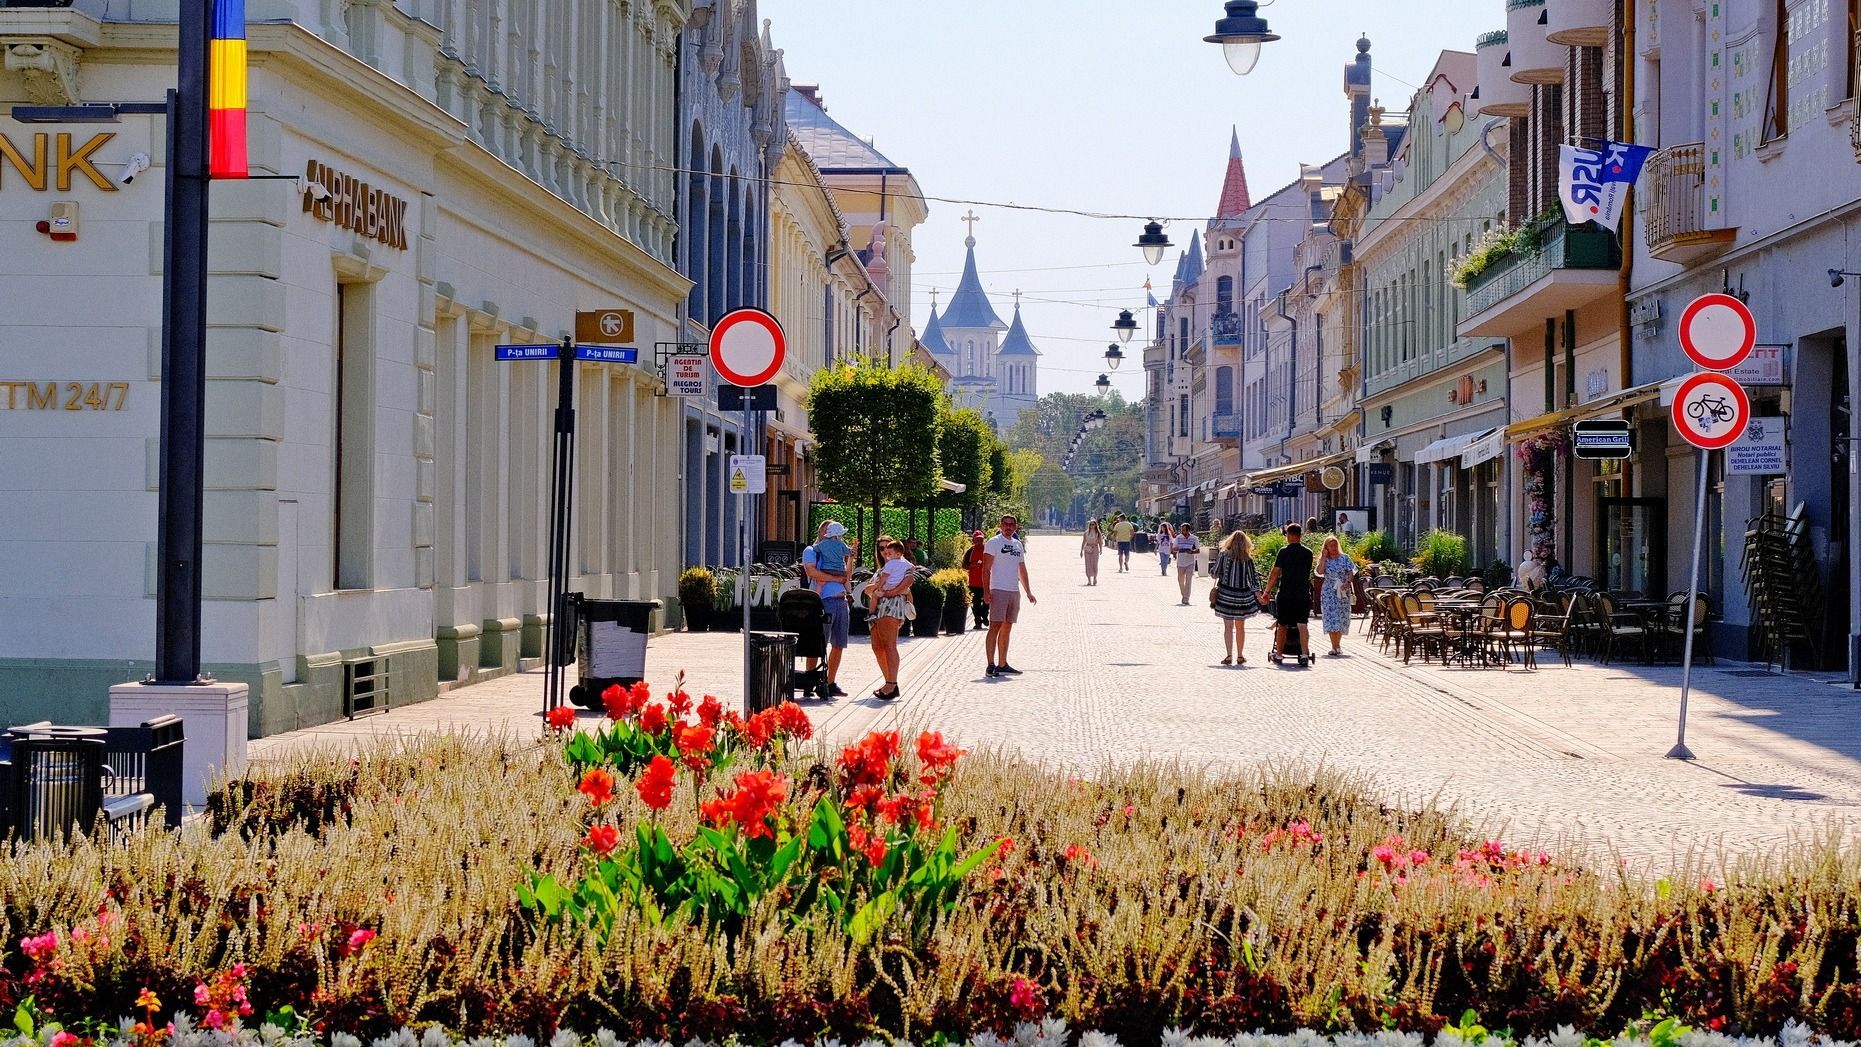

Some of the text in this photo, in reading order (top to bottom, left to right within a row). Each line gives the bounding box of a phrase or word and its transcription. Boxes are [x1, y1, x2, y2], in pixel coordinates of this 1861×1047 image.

[525, 348, 548, 356] UNIRII
[603, 350, 625, 359] UNIRII
[65, 382, 129, 411] 24/7
